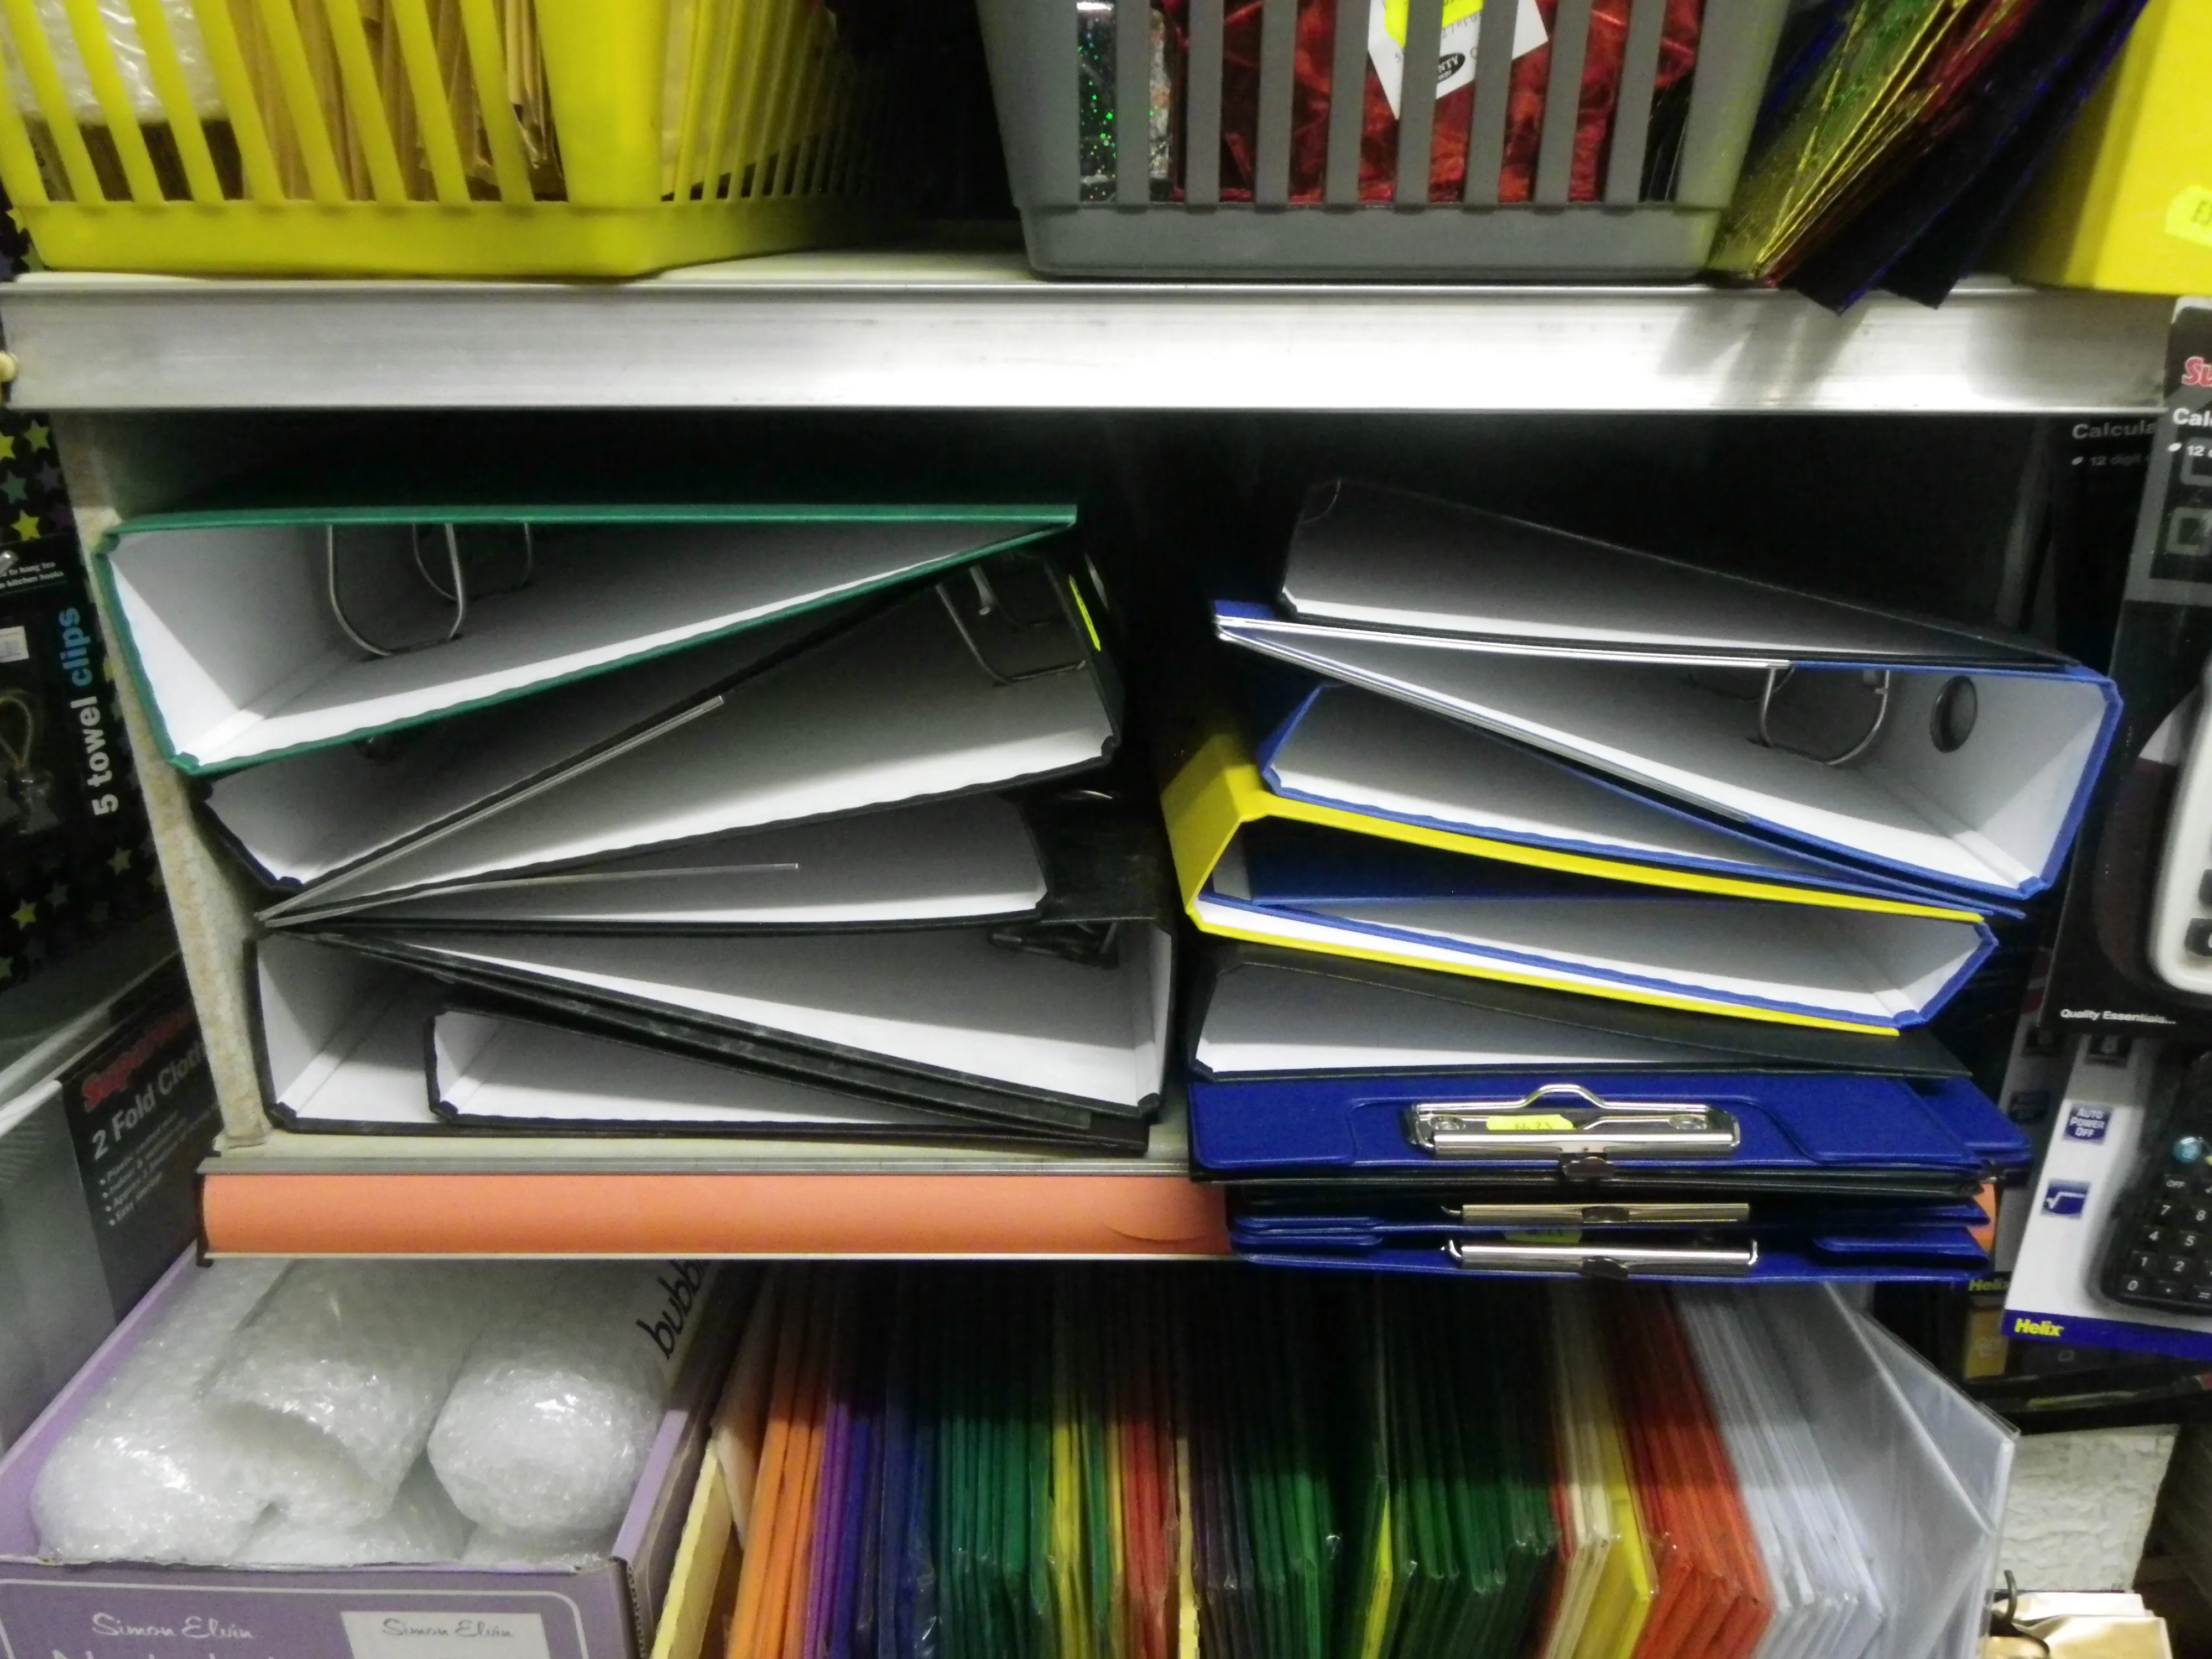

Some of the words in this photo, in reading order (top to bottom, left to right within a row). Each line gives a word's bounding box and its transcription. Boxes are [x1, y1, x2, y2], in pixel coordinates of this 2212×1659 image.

[2173, 408, 2212, 427] Cal
[2187, 445, 2205, 456] 12
[59, 607, 93, 687] clips
[70, 696, 112, 787] towel
[92, 794, 119, 816] 5
[2060, 1009, 2101, 1021] Quality
[93, 1129, 109, 1160] 2
[112, 1084, 156, 1141] Fold
[2077, 1108, 2104, 1119] AUTO
[2070, 1117, 2105, 1128] POWER
[2075, 1126, 2094, 1137] OFF
[2161, 1204, 2171, 1215] 7
[2196, 1209, 2206, 1221] 8
[2148, 1230, 2158, 1241] 4
[2185, 1235, 2197, 1246] 5
[2141, 1256, 2148, 1267] 1
[2173, 1261, 2184, 1272] 2
[2014, 1318, 2064, 1337] Helix
[92, 1613, 176, 1636] Simon
[181, 1615, 256, 1639] Elvin
[382, 1618, 449, 1635] Simon
